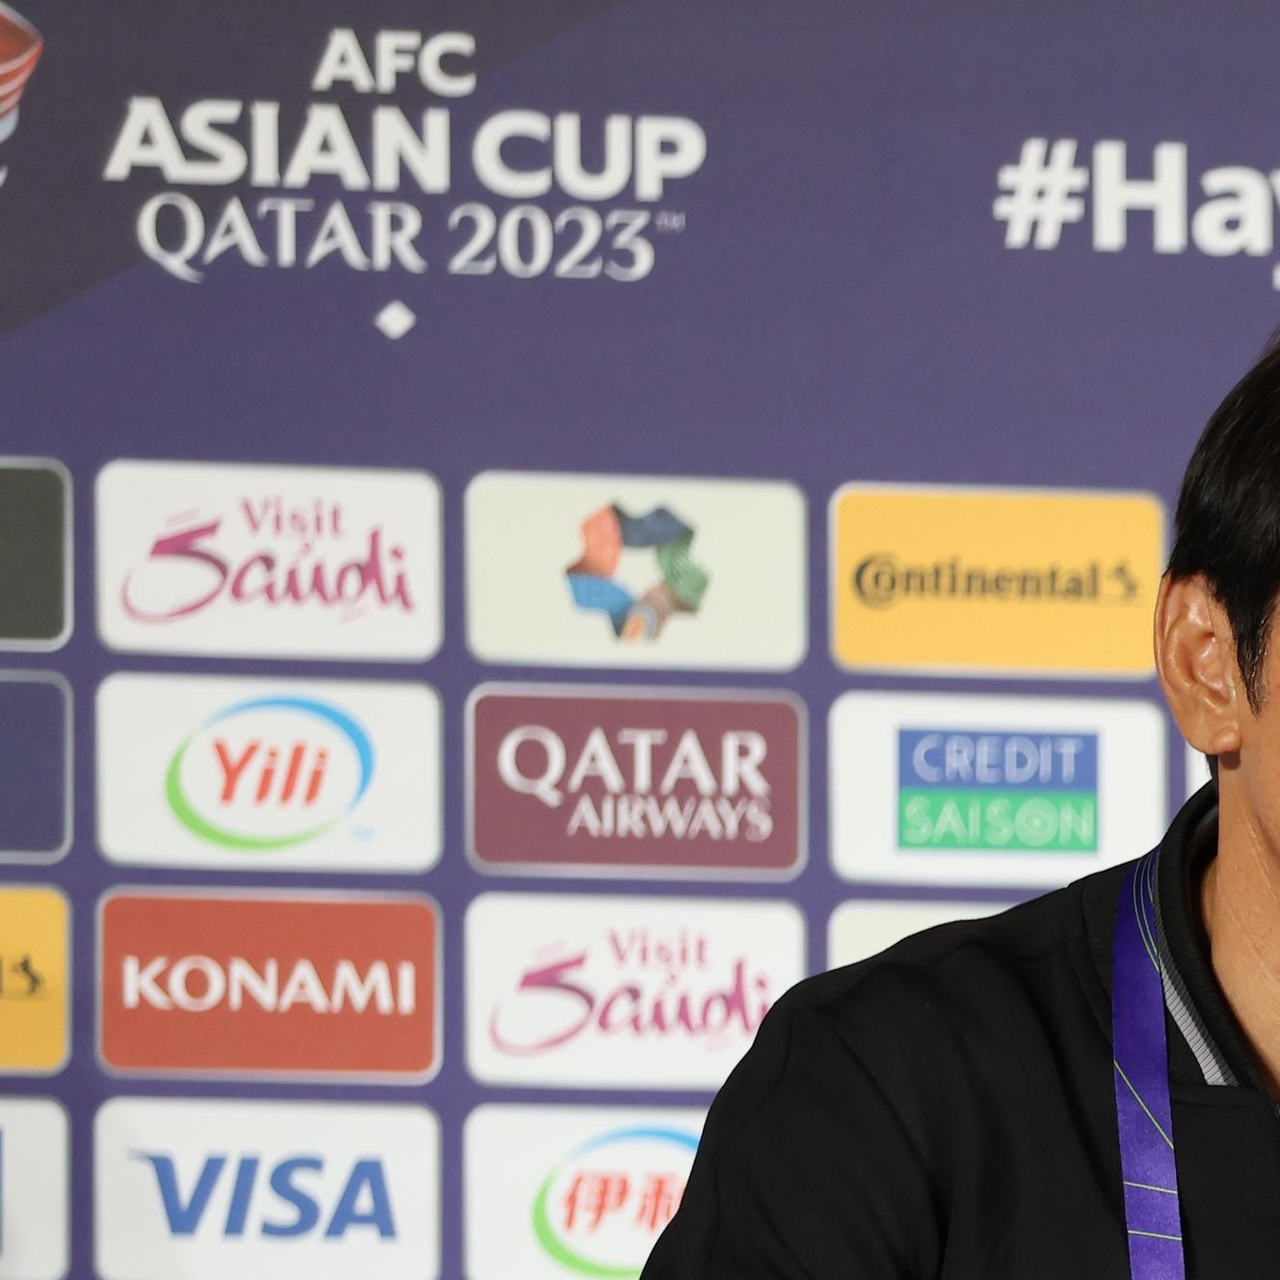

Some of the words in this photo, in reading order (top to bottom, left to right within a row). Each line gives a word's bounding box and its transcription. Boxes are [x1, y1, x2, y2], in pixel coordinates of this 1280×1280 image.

[311, 27, 477, 97] AFC
[103, 96, 450, 194] ASIAN
[471, 110, 707, 202] CUP
[136, 192, 429, 284] QATAR
[447, 203, 657, 282] 2023
[242, 496, 345, 539] Visit
[119, 519, 415, 626] Saudi
[852, 551, 1100, 610] Continental
[213, 736, 330, 807] Yili
[497, 723, 771, 808] QATAR
[912, 734, 1085, 785] CREDIT
[566, 794, 774, 843] AIRWAYS
[902, 795, 1095, 847] SAISON
[608, 926, 709, 976] Visit
[121, 954, 416, 1016] KONAMI
[128, 1149, 398, 1241] VISA
